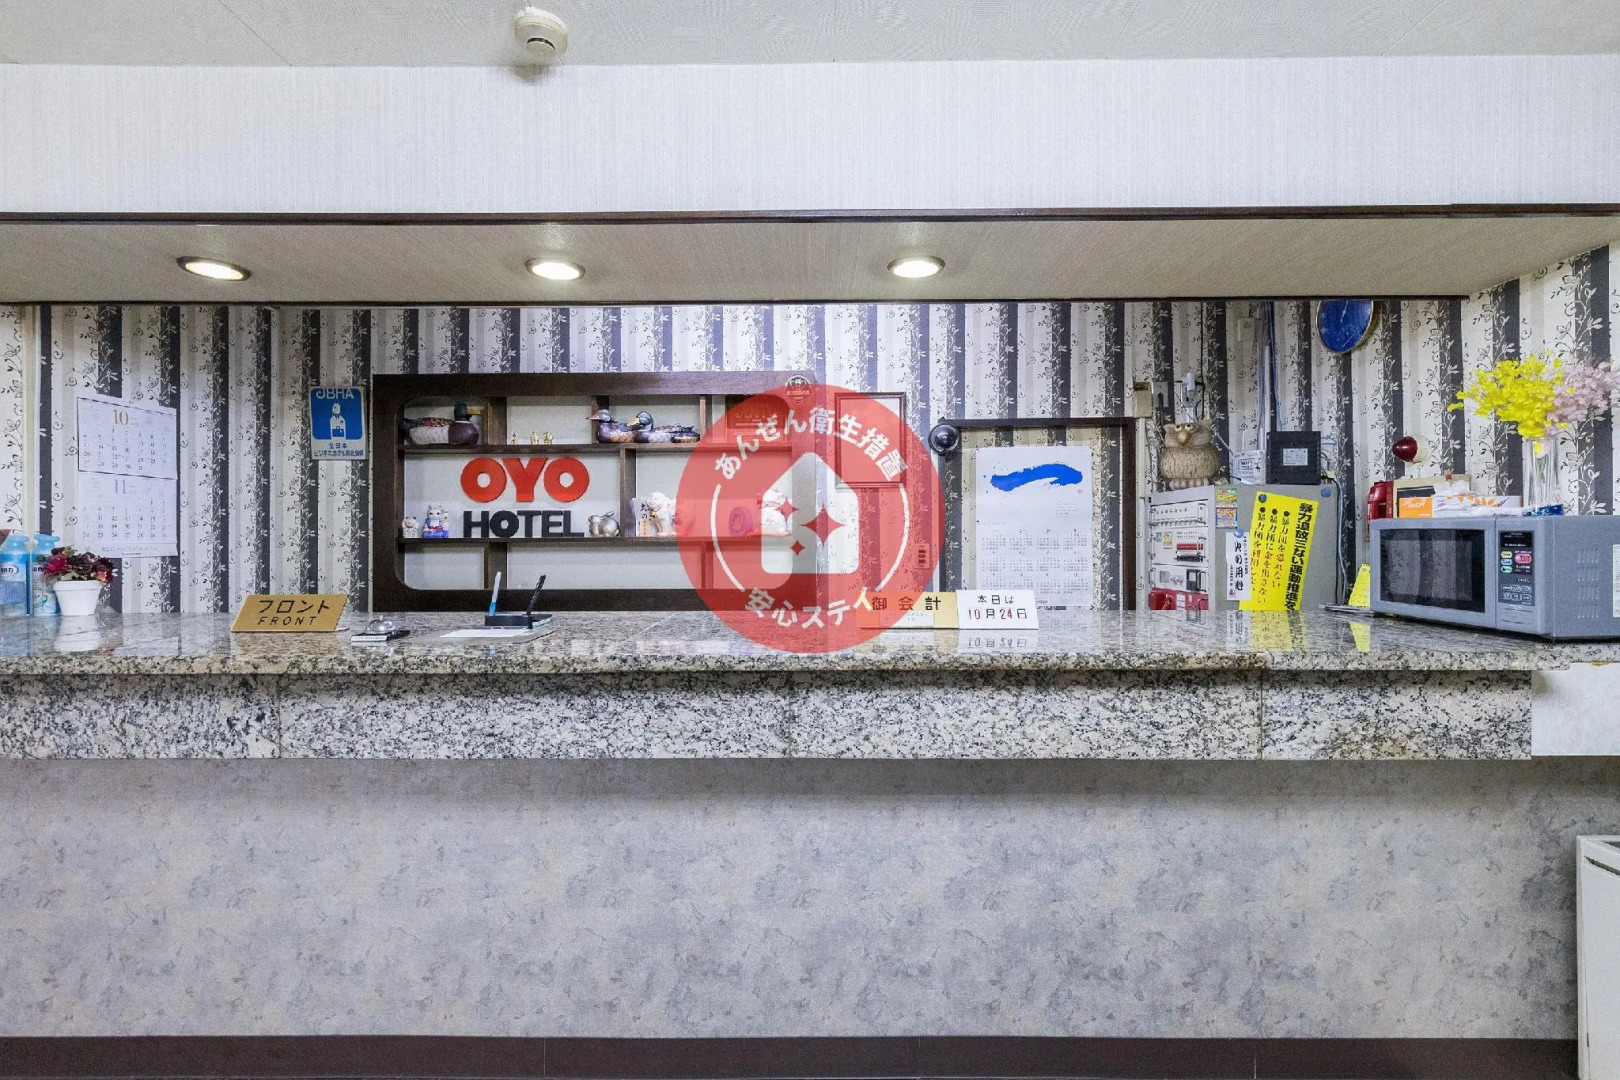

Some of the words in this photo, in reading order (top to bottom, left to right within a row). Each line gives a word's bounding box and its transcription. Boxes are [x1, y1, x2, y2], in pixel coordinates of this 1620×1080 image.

[316, 388, 354, 399] JBHA
[114, 409, 129, 425] 10
[114, 480, 126, 494] 11
[460, 457, 589, 503] OYO
[463, 510, 584, 538] HOTEL
[871, 596, 941, 611] 御会計
[977, 594, 1014, 605] 本日は
[258, 600, 330, 614] フロント
[968, 608, 1027, 619] 10月24日
[257, 616, 317, 626] FRONT
